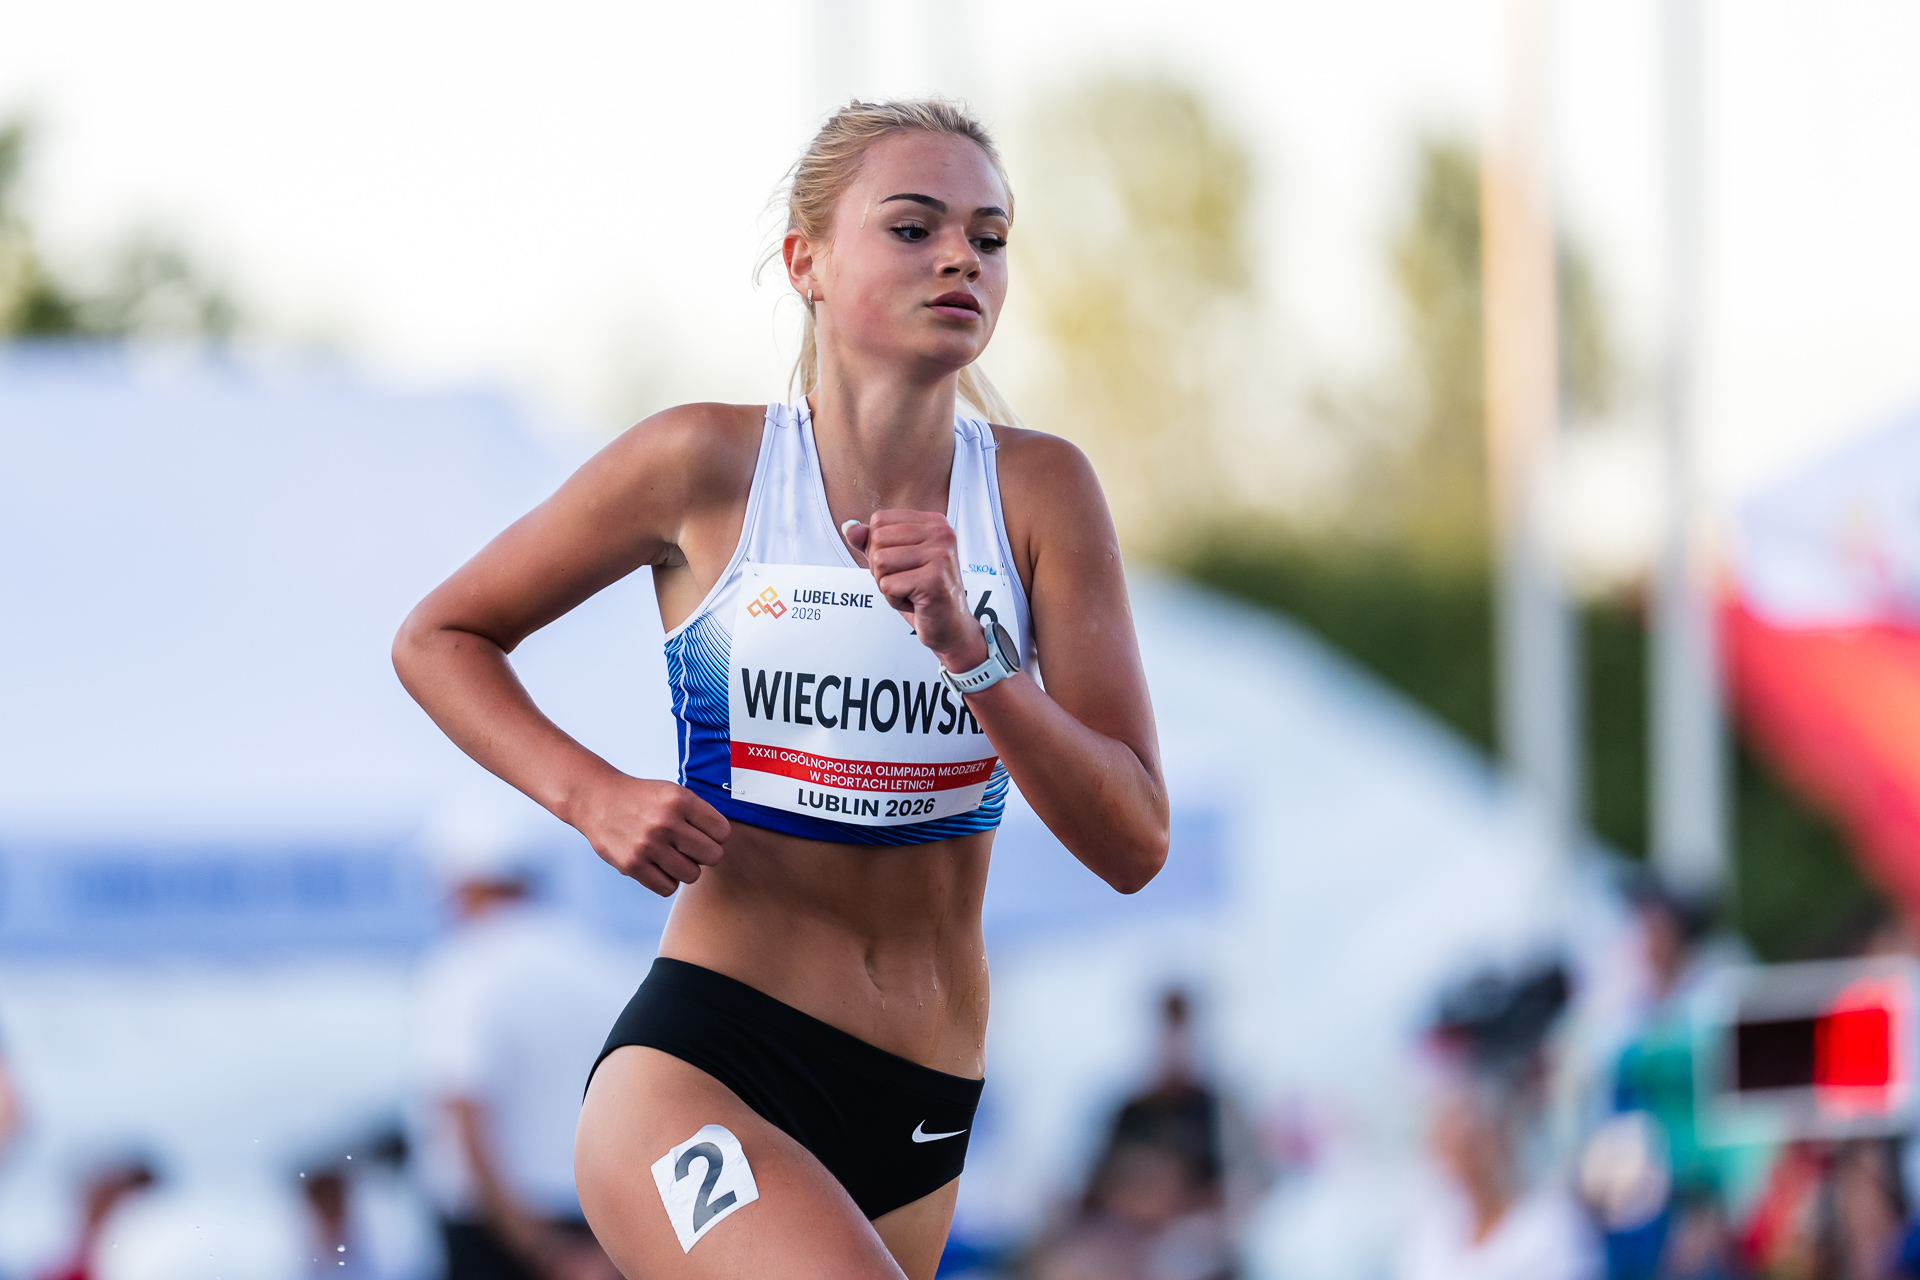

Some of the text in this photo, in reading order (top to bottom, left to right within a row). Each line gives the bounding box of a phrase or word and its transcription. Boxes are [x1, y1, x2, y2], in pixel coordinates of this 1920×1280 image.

[793, 589, 874, 608] LUBELSKIE
[791, 607, 821, 621] 2026
[741, 667, 985, 735] WIECHOWSK
[748, 746, 987, 777] XXXII OGÓLNOPOLSKA OLIMPIADA MŁODZIEŻY
[809, 770, 934, 790] W SPORTACH LETNICH
[798, 788, 936, 817] LUBLIN 2026
[674, 1141, 738, 1234] 2
